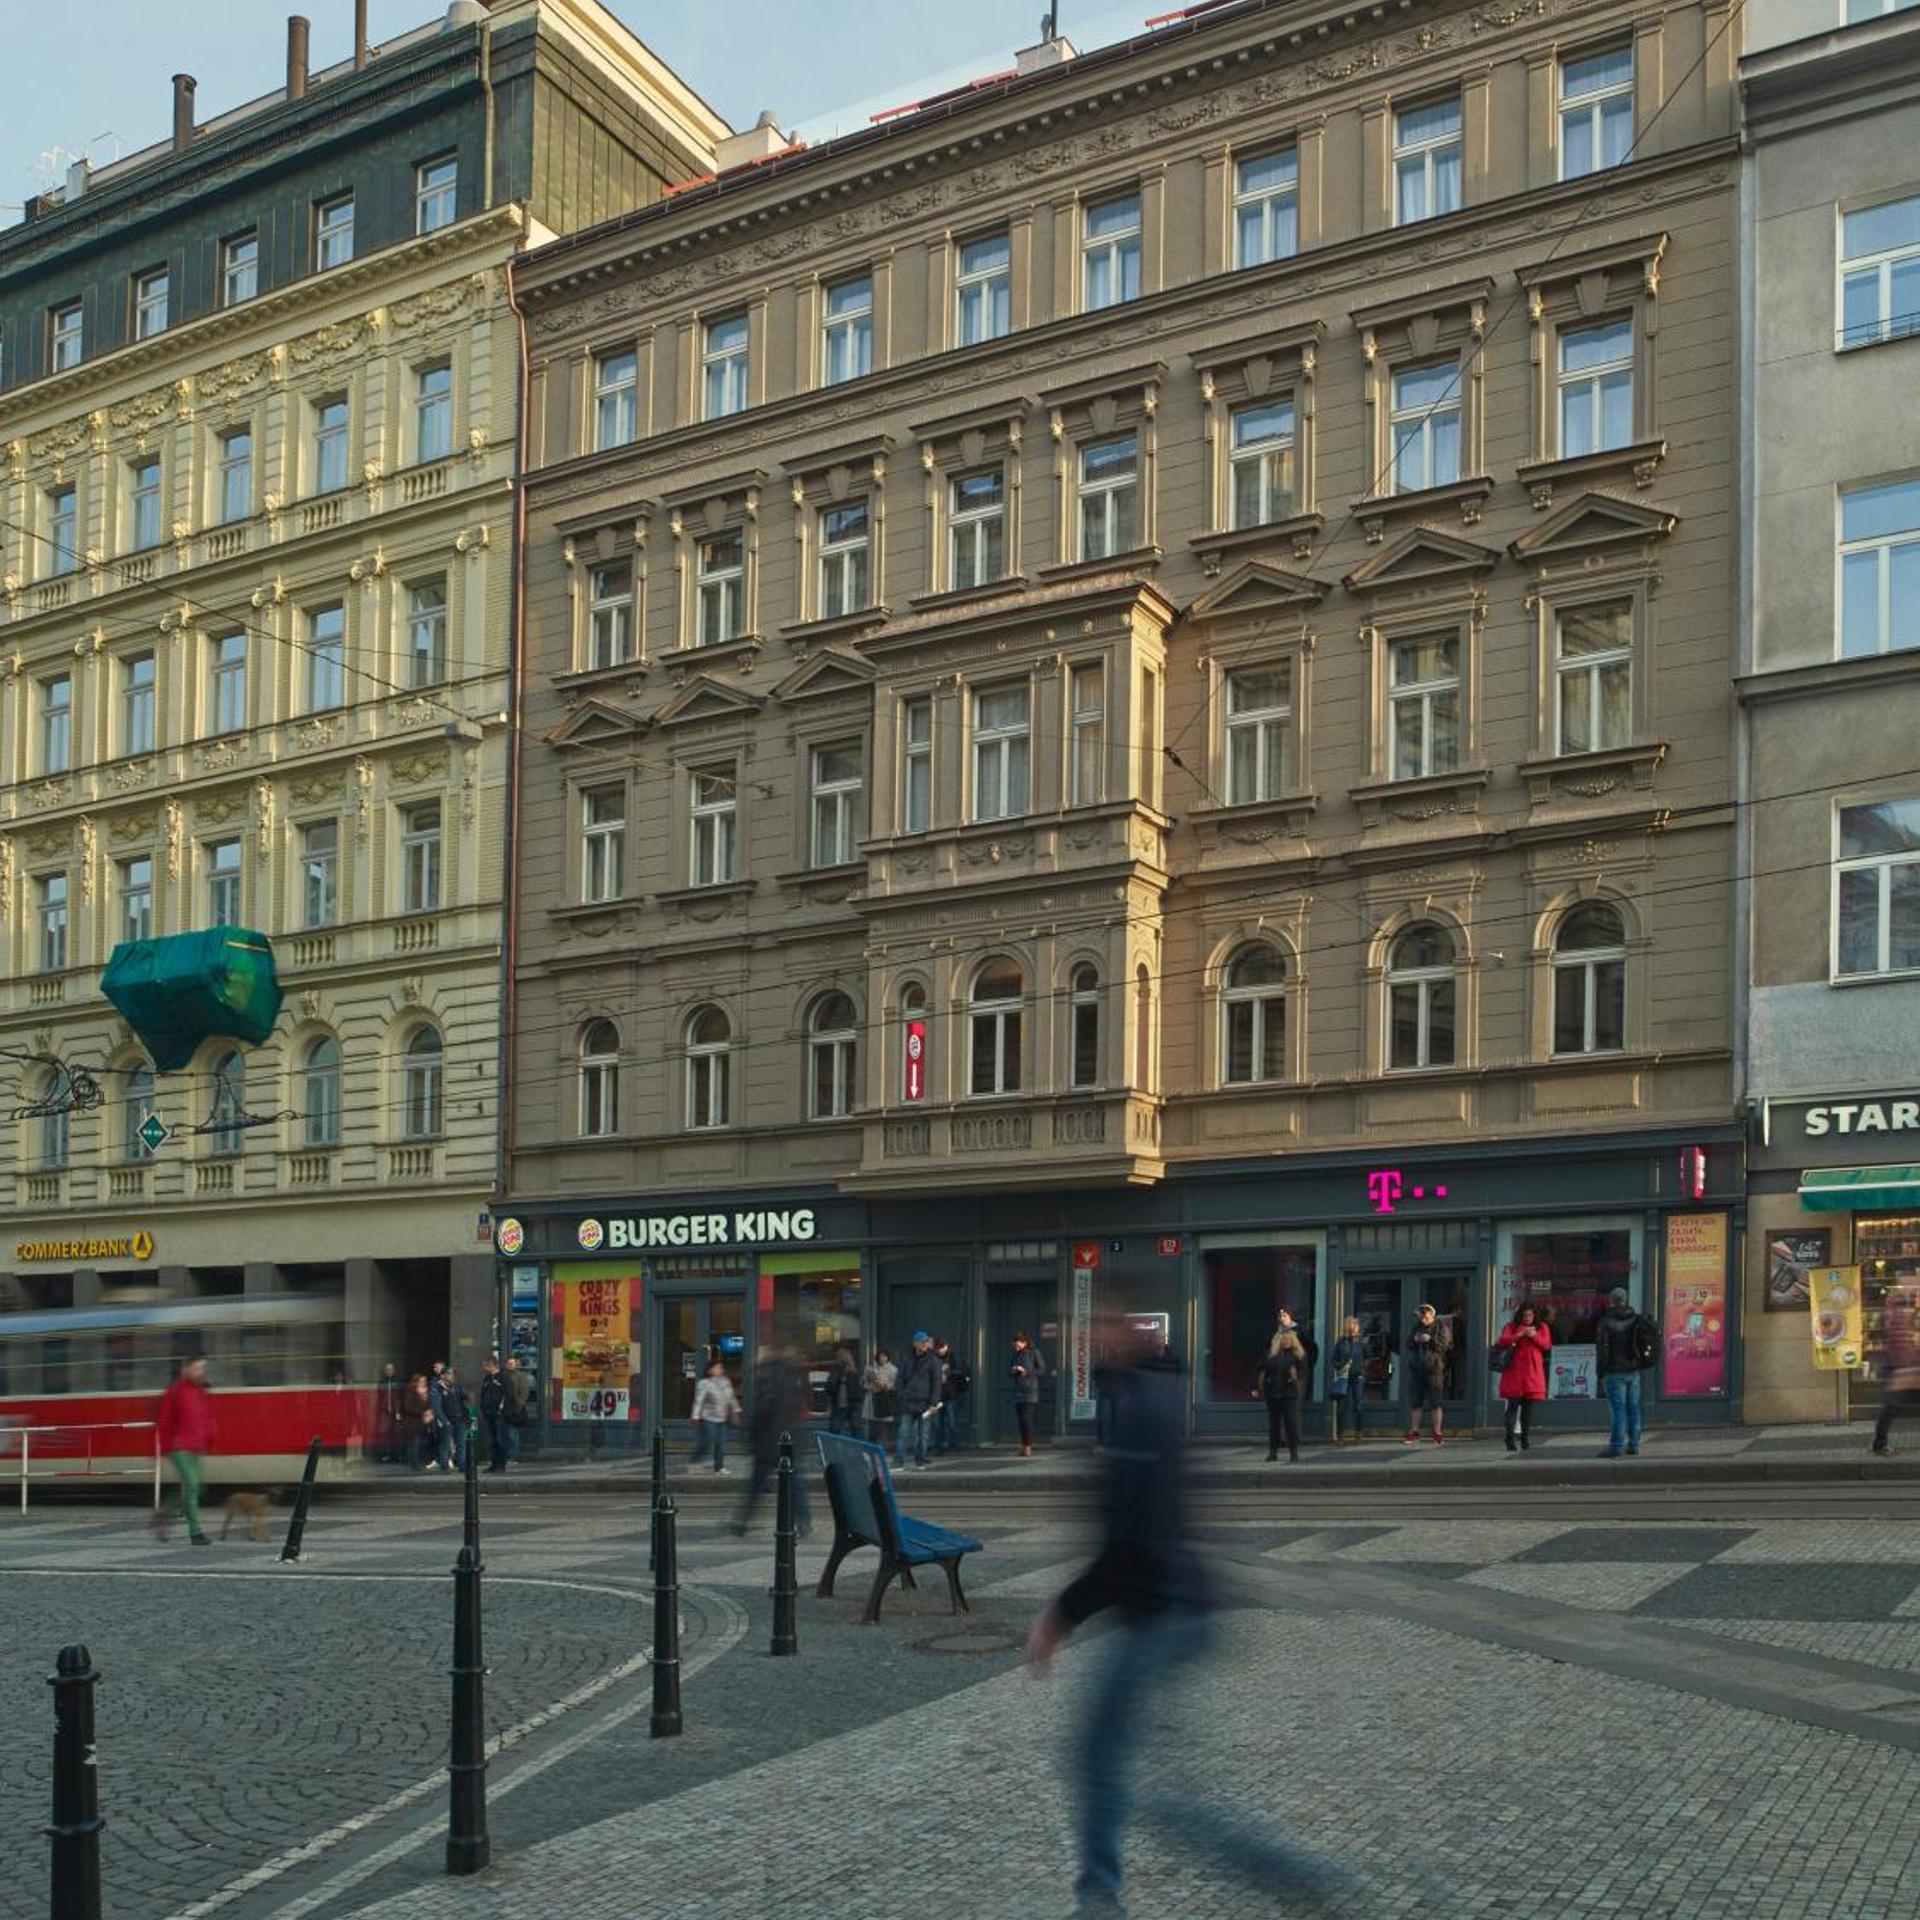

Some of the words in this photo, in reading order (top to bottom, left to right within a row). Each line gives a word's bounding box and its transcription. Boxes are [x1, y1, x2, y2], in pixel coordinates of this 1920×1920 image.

[608, 1213, 728, 1248] BURGER
[734, 1209, 816, 1243] KING
[15, 1239, 129, 1260] COMMERZBANK
[590, 1389, 617, 1417] 49
